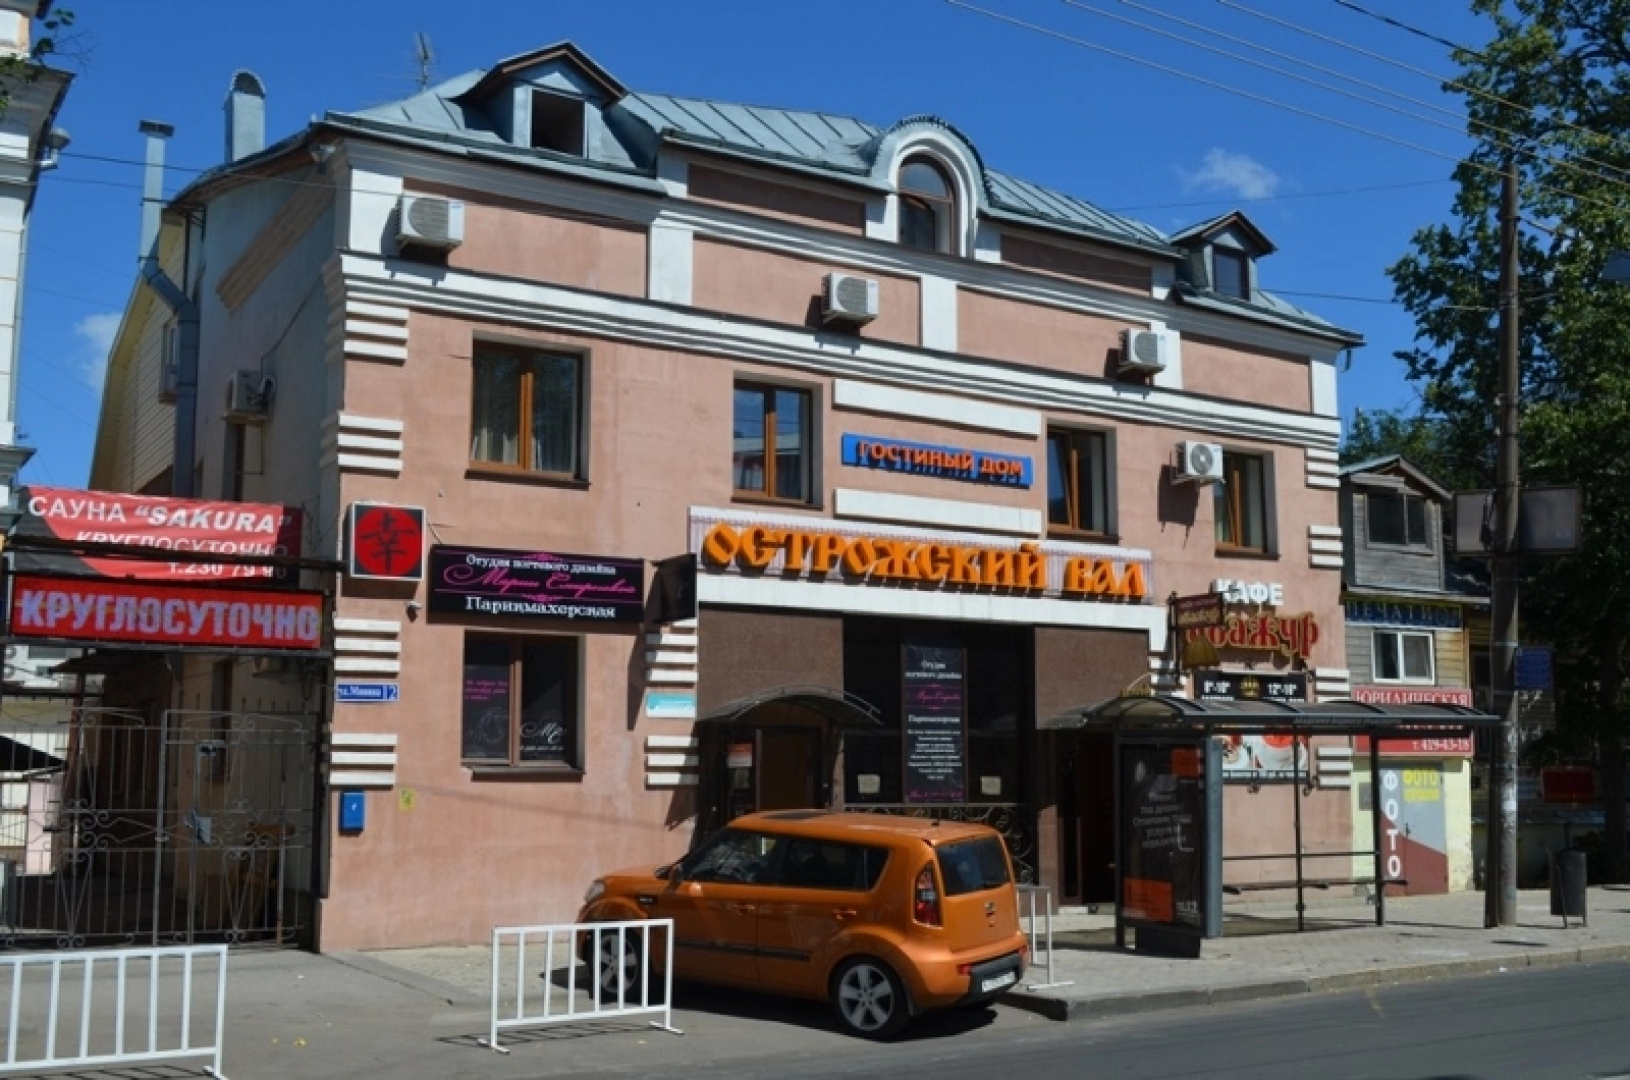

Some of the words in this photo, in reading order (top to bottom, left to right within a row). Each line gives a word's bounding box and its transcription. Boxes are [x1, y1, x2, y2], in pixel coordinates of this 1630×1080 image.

[858, 440, 974, 470] ГОСТИНЫЙ
[980, 456, 1023, 476] ДОМ
[28, 496, 126, 523] САУНА
[703, 522, 1047, 589] ОСТРОЖСКИЙ
[1064, 557, 1146, 595] ВАЛ
[20, 589, 319, 640] КРУГЛОСУТОЧНО
[465, 595, 616, 619] Парикмахерская
[1186, 612, 1320, 659] ажур
[1383, 769, 1401, 878] ФОТО
